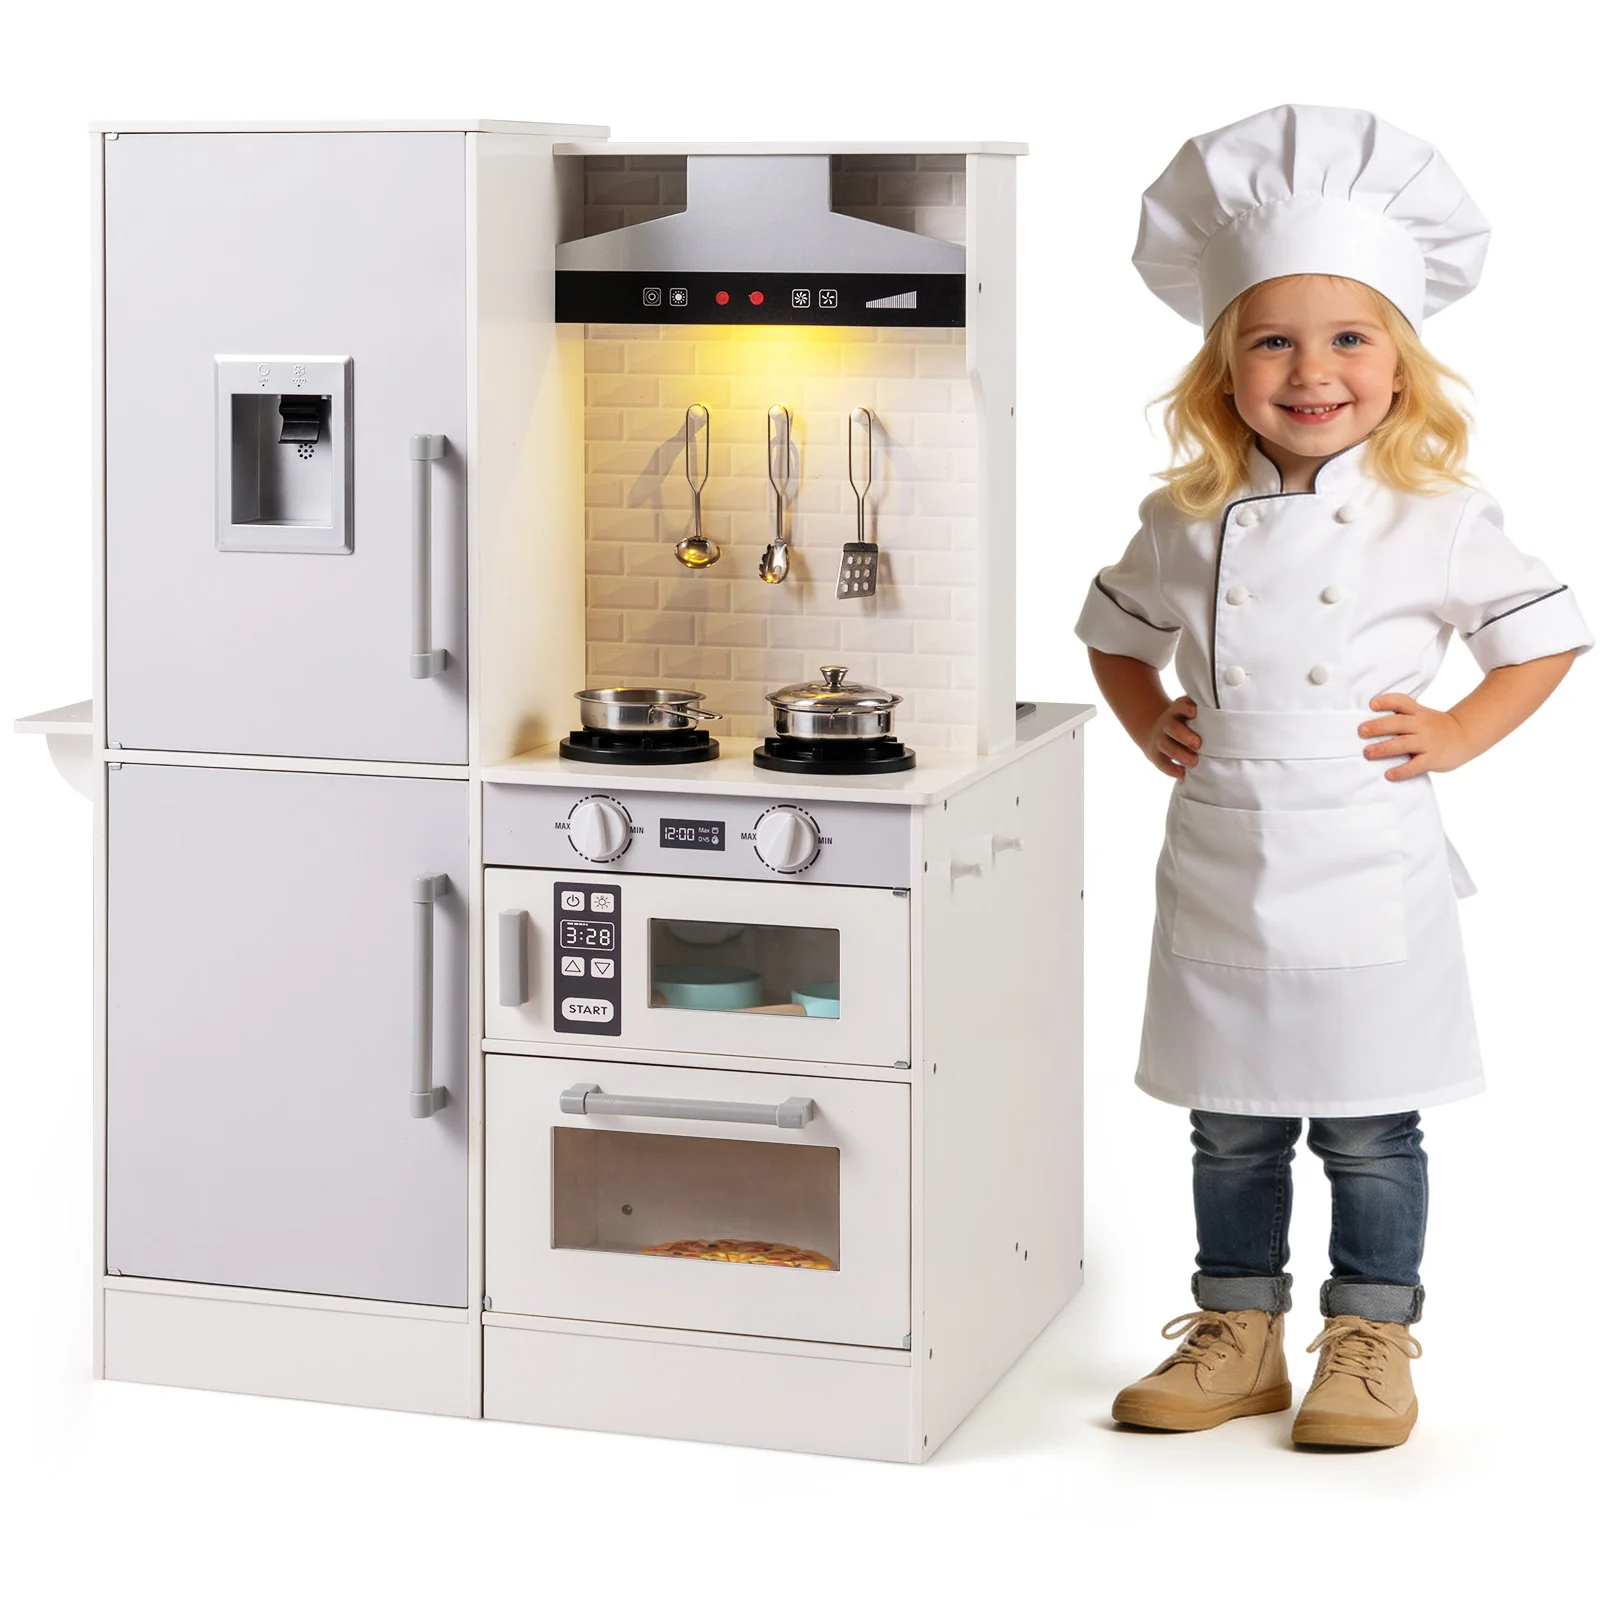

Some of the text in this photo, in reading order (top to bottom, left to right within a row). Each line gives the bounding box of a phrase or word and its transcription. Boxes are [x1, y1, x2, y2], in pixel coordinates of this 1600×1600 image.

[554, 822, 571, 830] MAX
[629, 826, 644, 834] MIN
[664, 827, 695, 841] 12:00
[740, 832, 757, 840] MAX
[818, 836, 833, 845] MIN
[566, 927, 610, 946] 3:28
[568, 1004, 608, 1016] START
